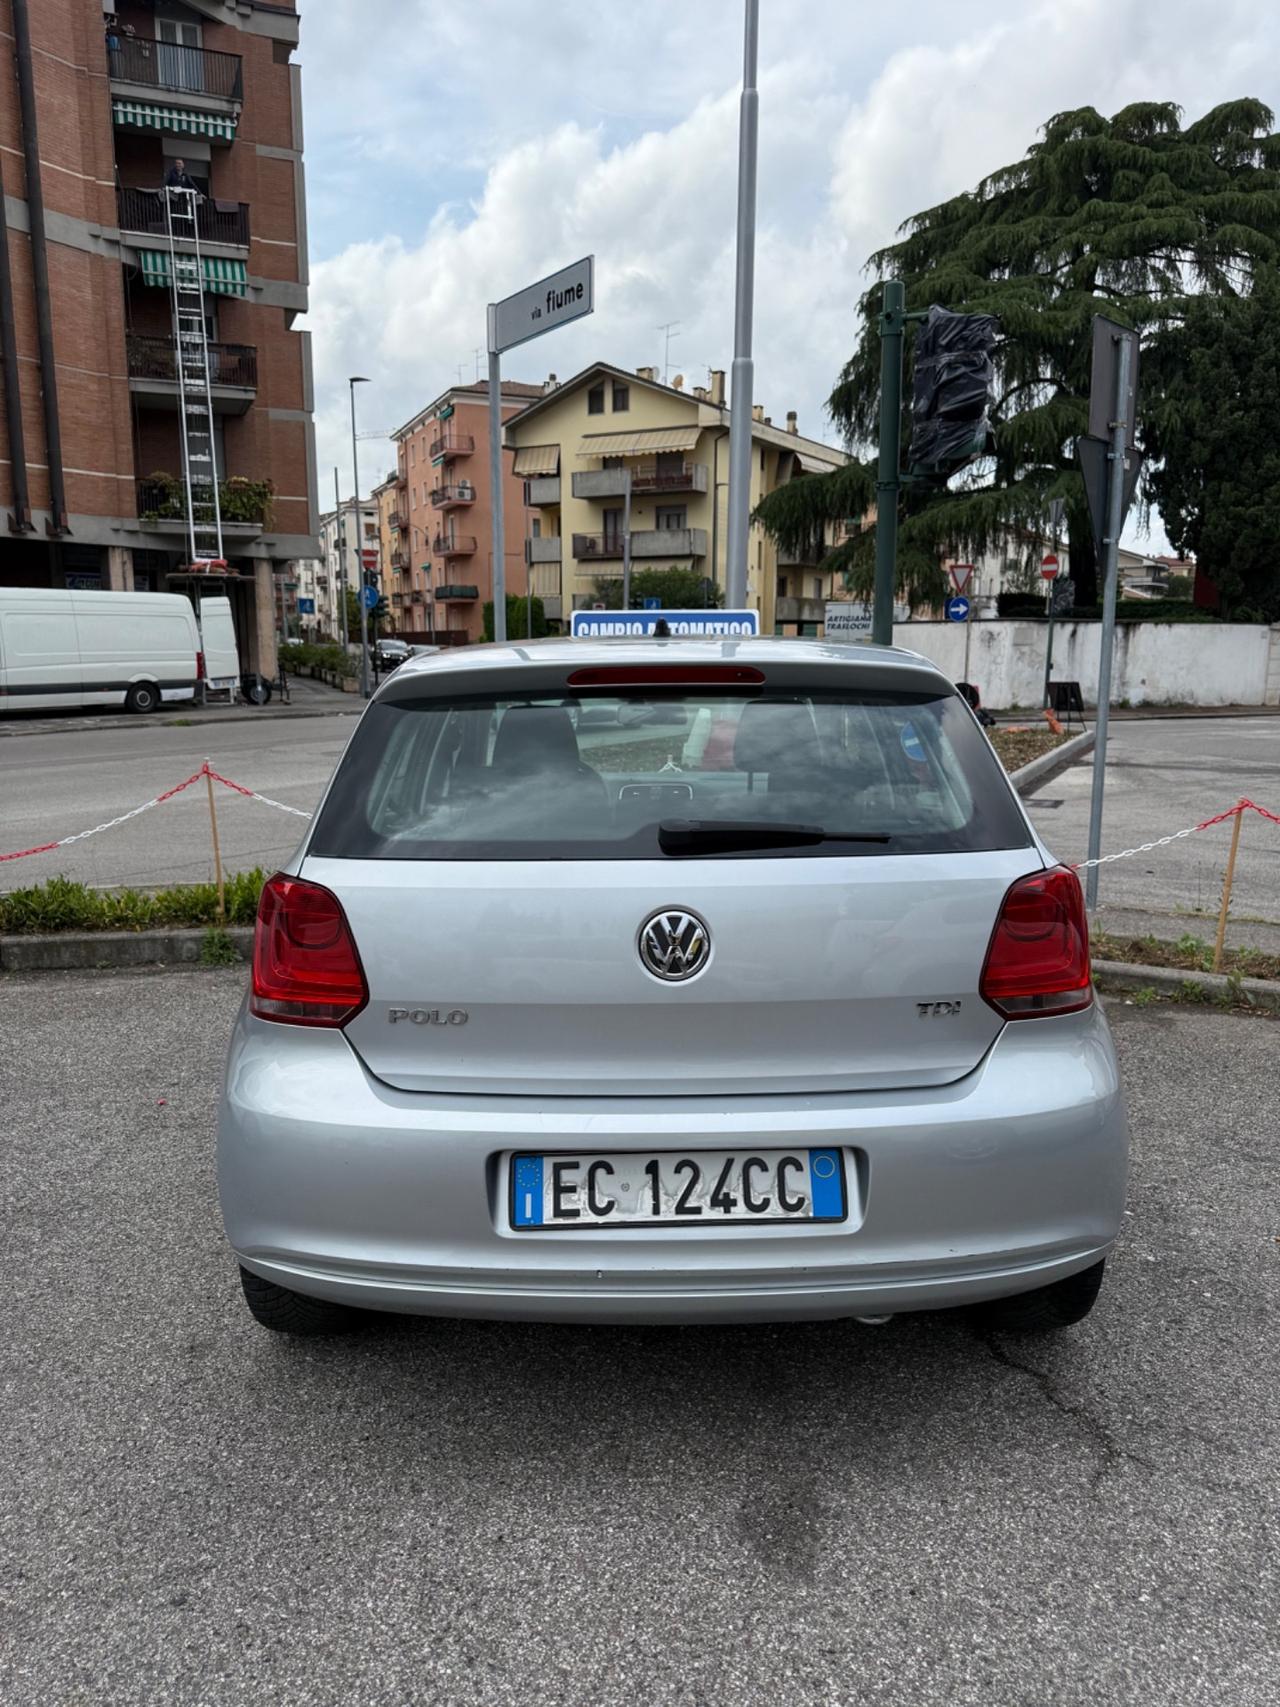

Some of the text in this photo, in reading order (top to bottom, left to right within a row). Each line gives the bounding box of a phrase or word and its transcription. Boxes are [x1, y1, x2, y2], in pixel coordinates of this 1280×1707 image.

[531, 282, 584, 321] via fiume
[647, 622, 752, 636] ATOMATICO
[827, 622, 871, 630] TRASLOCHI
[388, 1007, 469, 1025] POLO
[916, 1001, 961, 1017] TDI
[552, 1156, 806, 1218] EC 124CC
[525, 1193, 532, 1218] I
